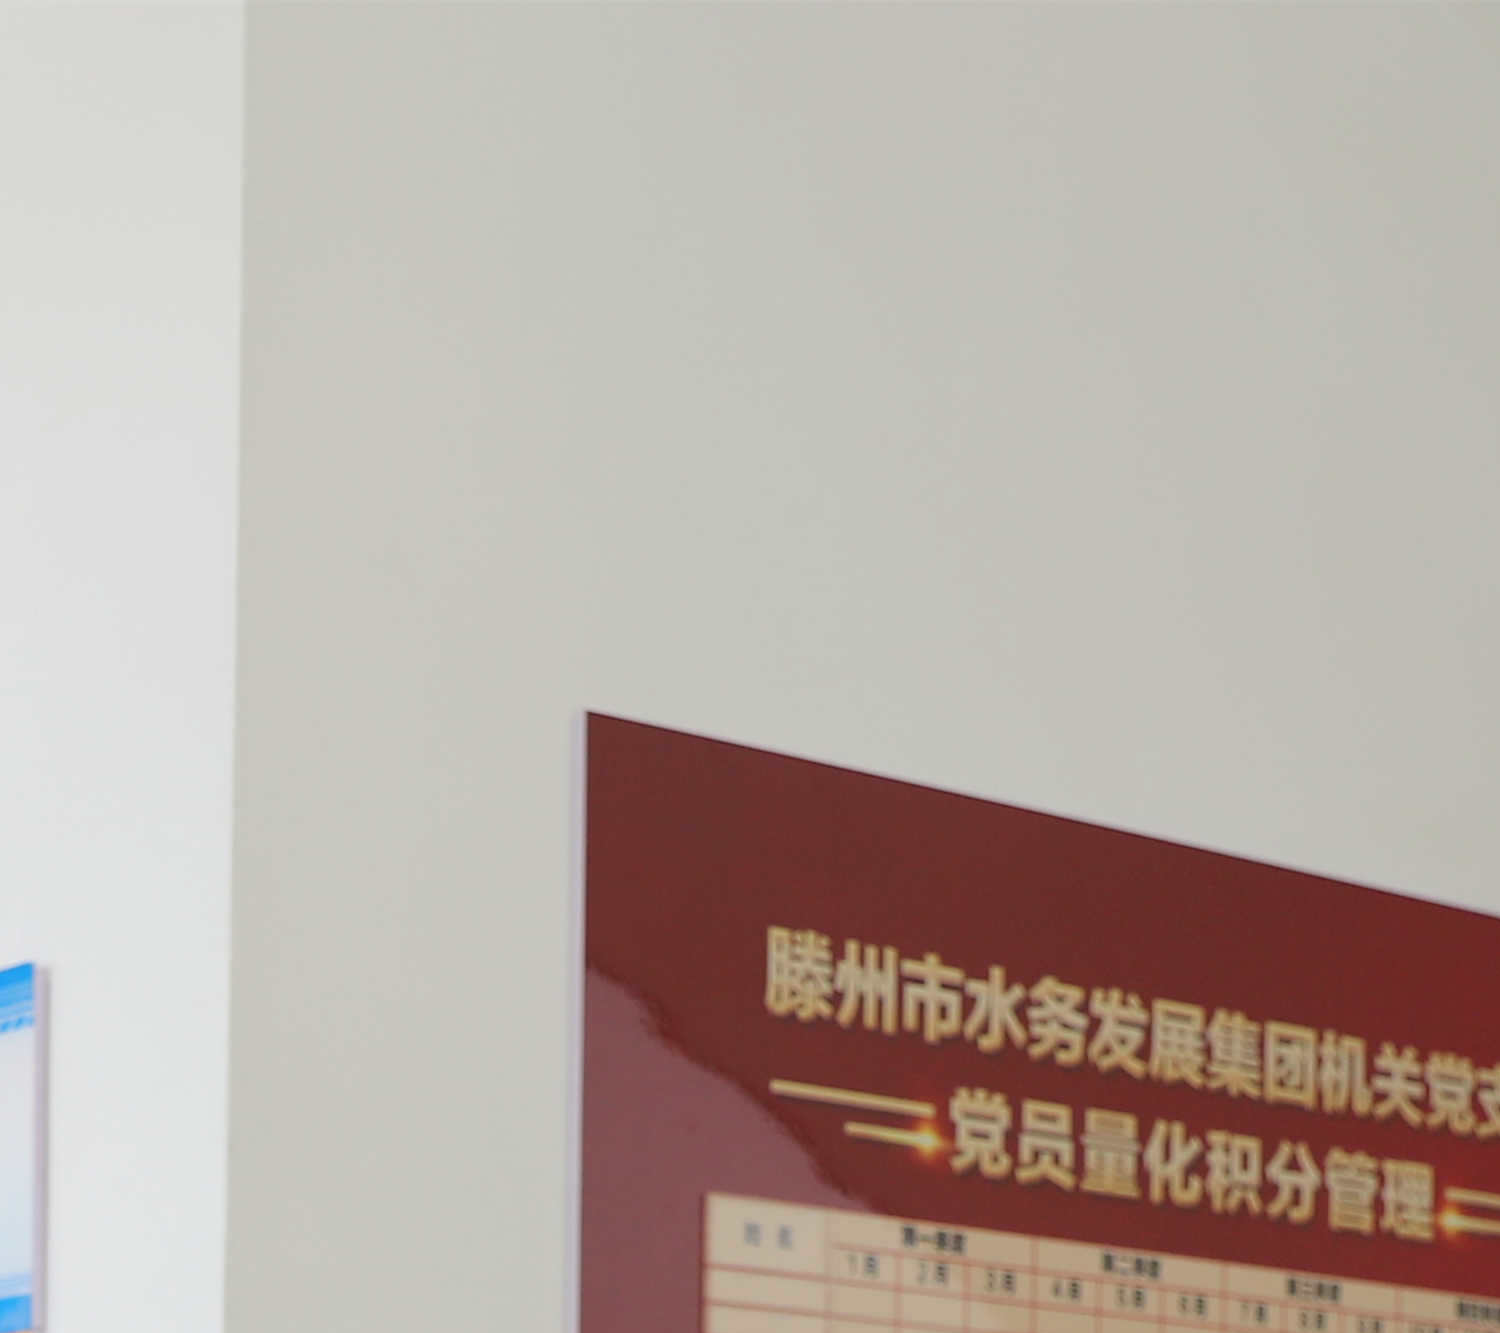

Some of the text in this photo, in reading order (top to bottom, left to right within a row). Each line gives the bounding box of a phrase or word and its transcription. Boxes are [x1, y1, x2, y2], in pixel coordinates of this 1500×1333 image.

[948, 1086, 1436, 1242] 党员量化积分管理
